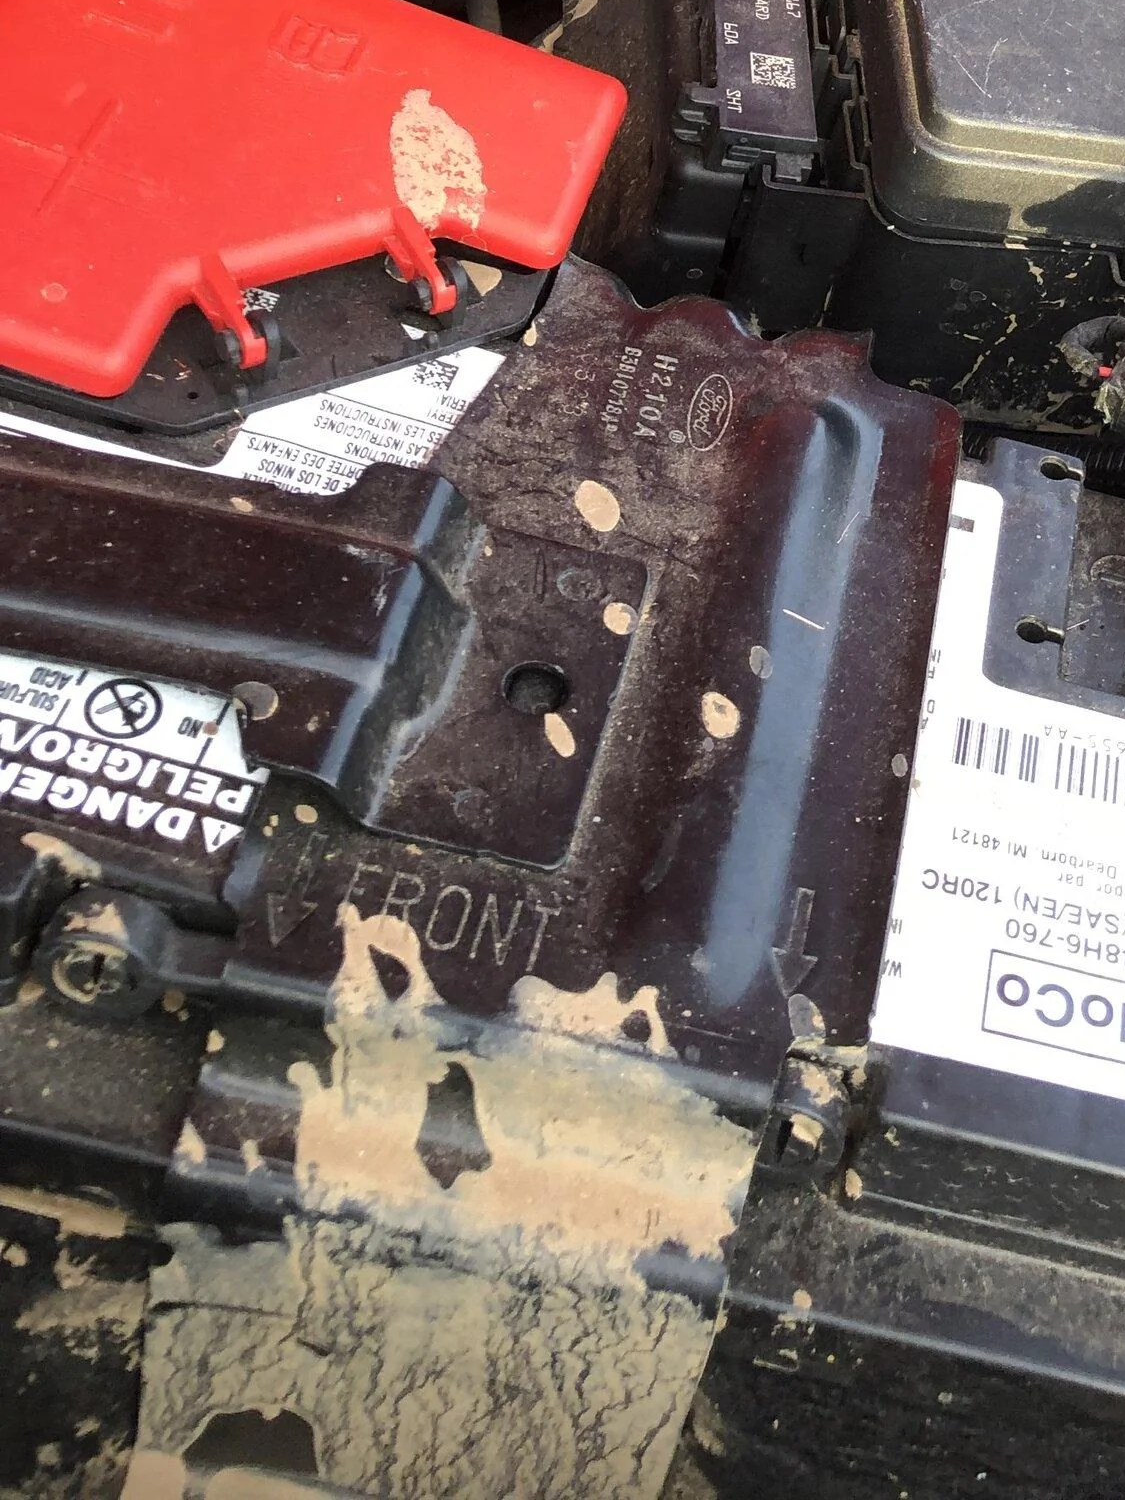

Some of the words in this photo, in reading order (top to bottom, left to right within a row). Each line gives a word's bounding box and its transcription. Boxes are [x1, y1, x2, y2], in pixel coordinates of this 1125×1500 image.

[723, 22, 738, 45] 60A
[320, 399, 402, 434] INSTRUCTIONS
[314, 415, 404, 451] INSTRUCCIONES
[404, 425, 425, 440] LES
[247, 437, 298, 461] ENFANTS.
[301, 452, 324, 468] DES
[407, 443, 430, 458] LAS
[257, 458, 293, 480] NIÑOS
[300, 470, 321, 486] LOS
[322, 475, 340, 491] DE
[30, 667, 74, 690] ACID
[178, 716, 203, 739] NO
[951, 826, 1001, 852] 48121
[1007, 841, 1027, 858] MI
[920, 867, 1005, 905] 120RC
[1057, 872, 1085, 888] par
[1096, 882, 1124, 898] por
[342, 861, 563, 973] FRONT
